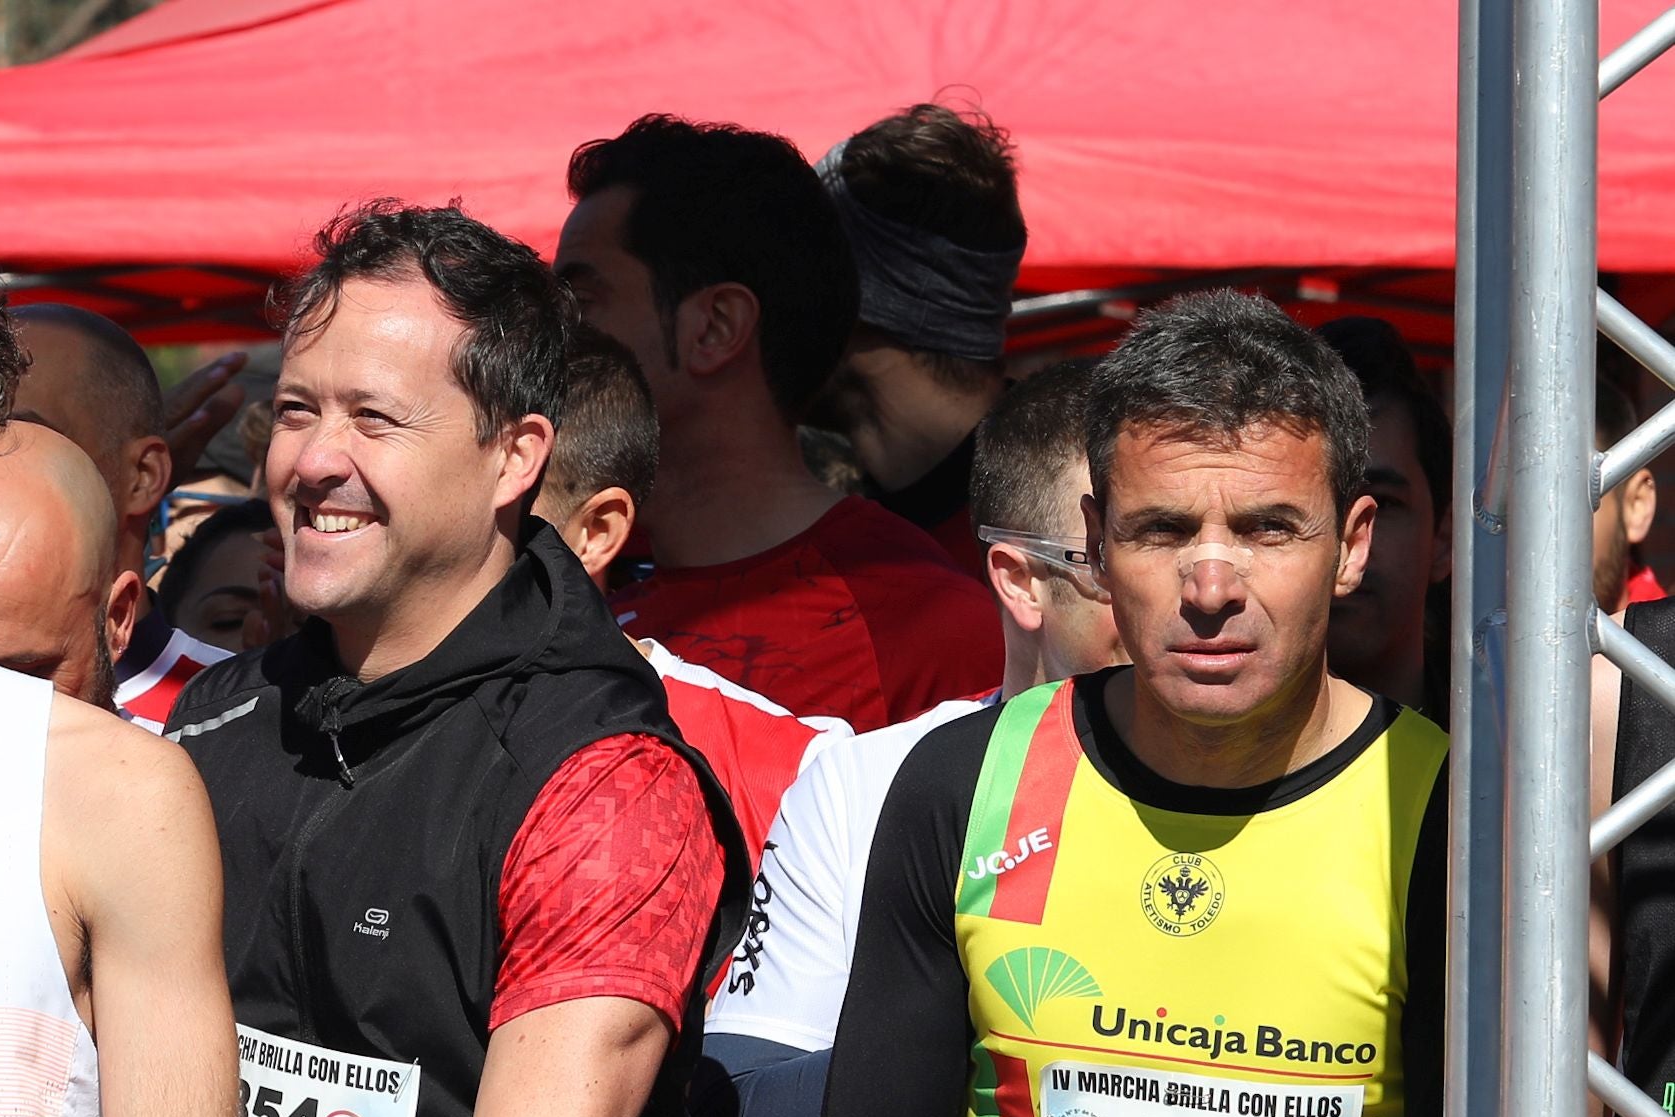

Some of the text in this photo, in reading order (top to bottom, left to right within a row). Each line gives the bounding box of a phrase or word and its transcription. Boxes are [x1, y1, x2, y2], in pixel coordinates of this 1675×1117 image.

[1173, 855, 1202, 867] CLUB
[1144, 882, 1222, 934] ATLETISMO TOLEDO
[1091, 1005, 1377, 1064] Unicaja Banco
[258, 1042, 303, 1076] BRILLA
[308, 1055, 341, 1084] CON
[345, 1063, 401, 1095] ELLOS
[1052, 1069, 1071, 1091] IV
[1078, 1071, 1160, 1103] MARCHA
[1165, 1081, 1231, 1113] BRILLA
